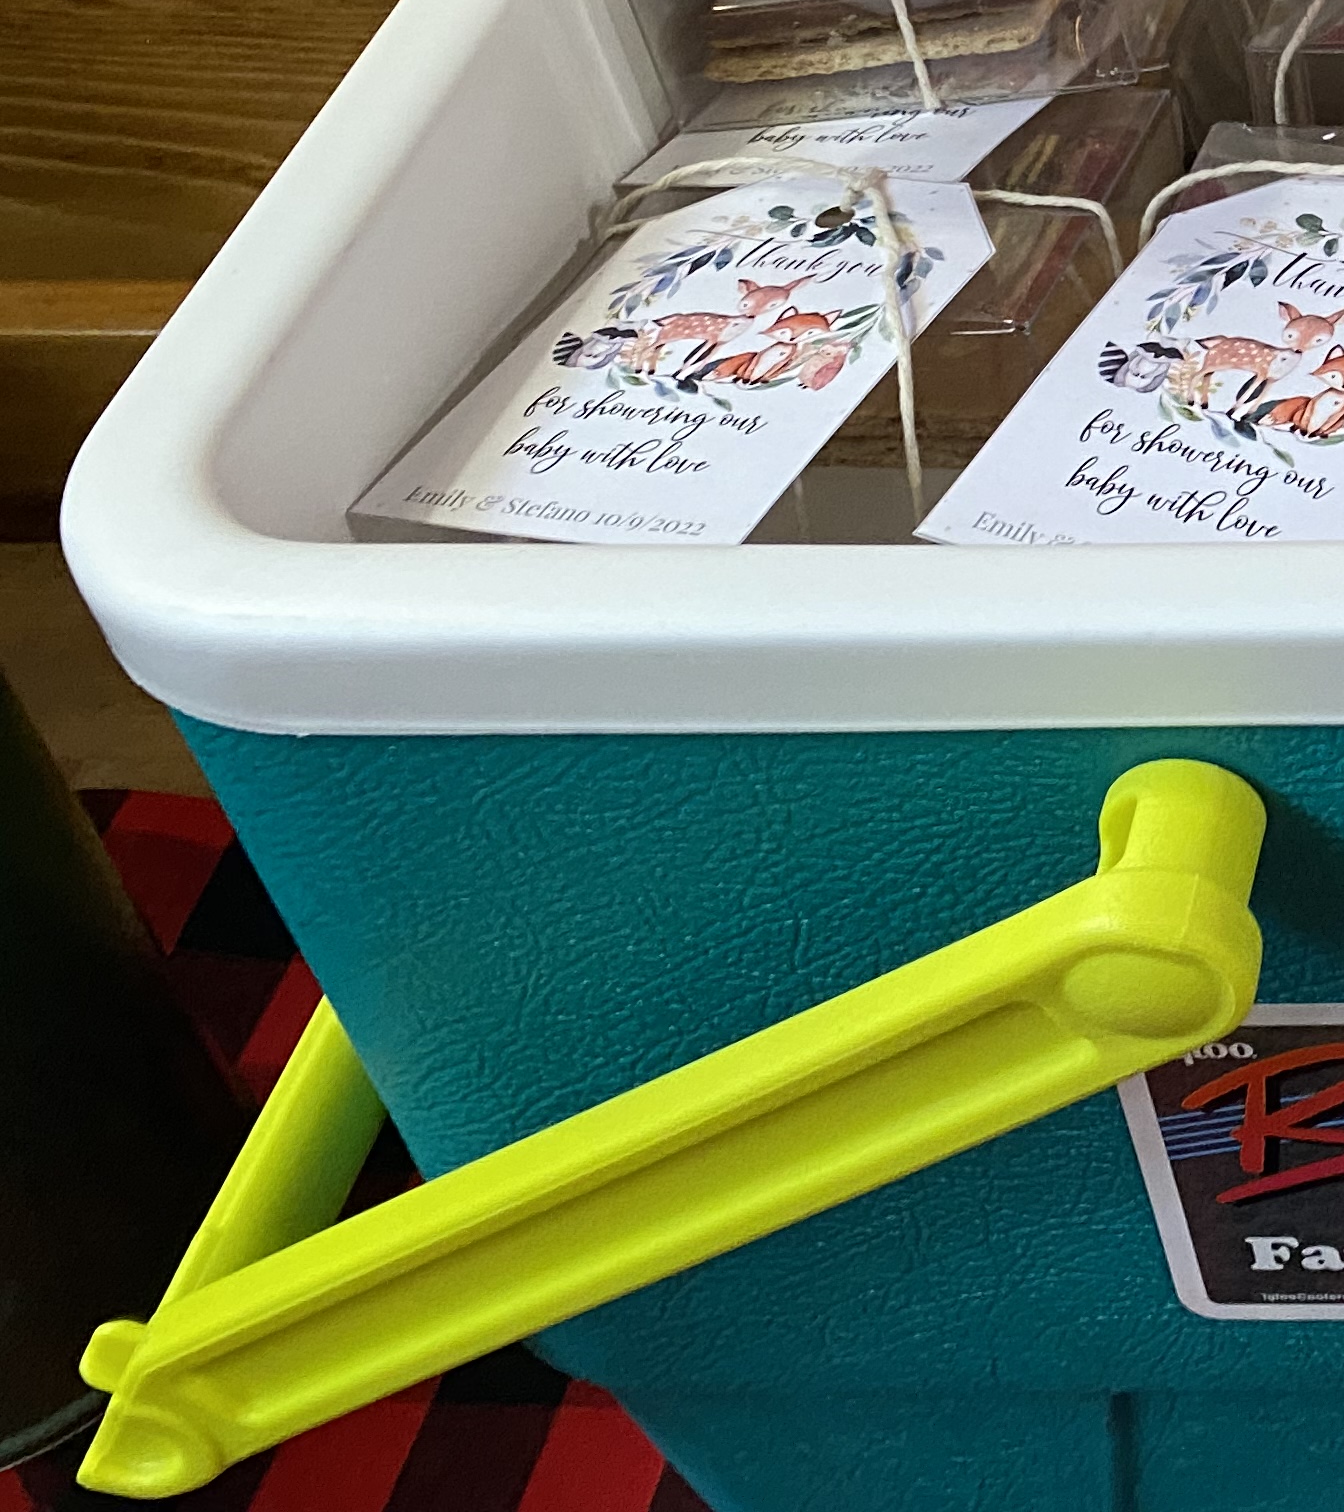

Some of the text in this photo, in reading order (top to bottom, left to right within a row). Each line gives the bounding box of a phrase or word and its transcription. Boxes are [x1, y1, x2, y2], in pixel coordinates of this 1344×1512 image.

[747, 122, 930, 153] baby with love
[735, 237, 884, 284] thank you
[524, 385, 769, 440] for showering our
[502, 428, 712, 475] baby with love
[1079, 407, 1336, 500] for showering our
[402, 485, 707, 537] Emily & Stefano 10/9/2022
[1064, 455, 1282, 540] baby with love
